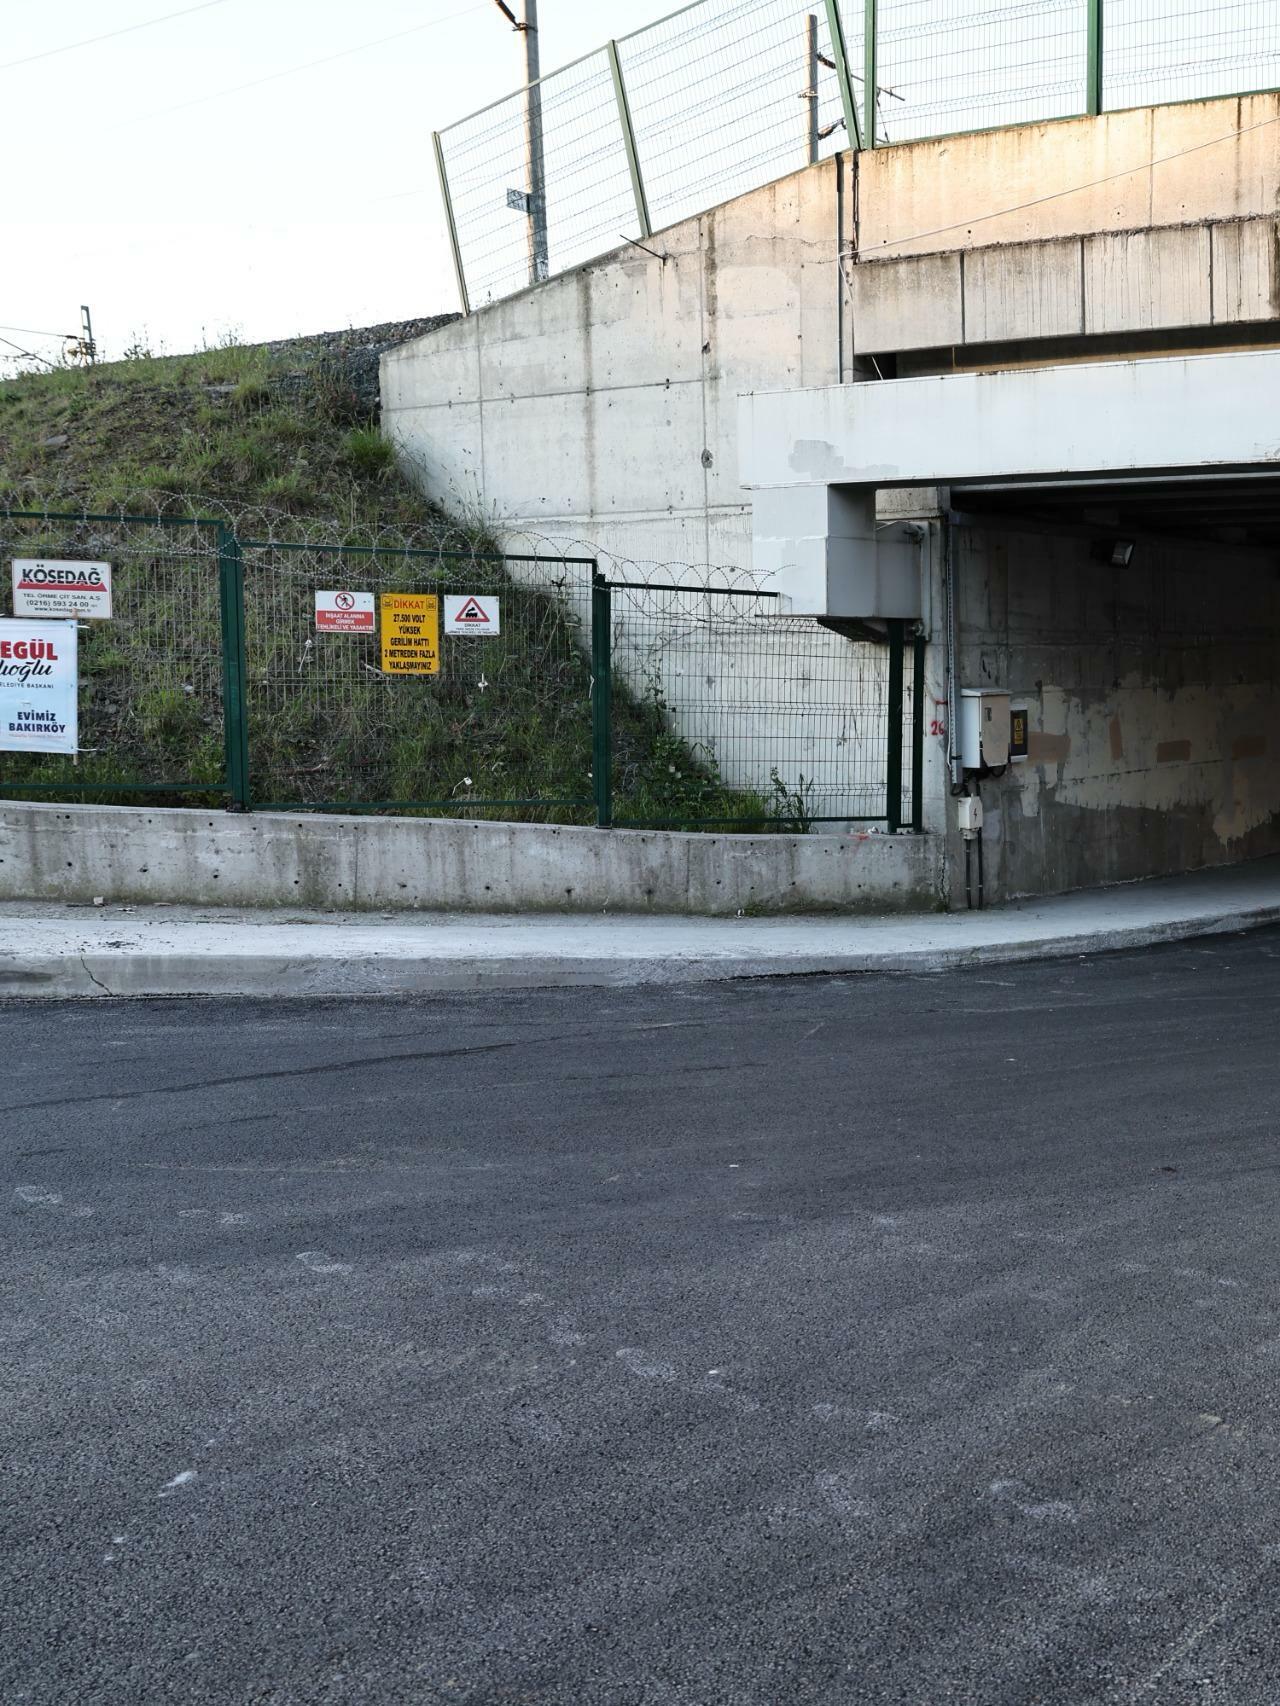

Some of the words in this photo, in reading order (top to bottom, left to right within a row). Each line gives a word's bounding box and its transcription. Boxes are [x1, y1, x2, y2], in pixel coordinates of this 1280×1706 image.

[22, 564, 101, 585] KÖSEDAĞ
[394, 599, 425, 609] DİKKAT
[393, 613, 411, 623] 27.500
[411, 614, 426, 623] VOLT
[398, 624, 421, 635] YÜKSEK
[390, 636, 412, 647] GERİLİM
[413, 638, 430, 647] HATTI
[384, 649, 388, 658] 2
[388, 649, 418, 659] METREDEN
[419, 649, 436, 659] FAZLA
[17, 710, 56, 722] EVİMİZ
[8, 721, 66, 734] BAKIRKÖY
